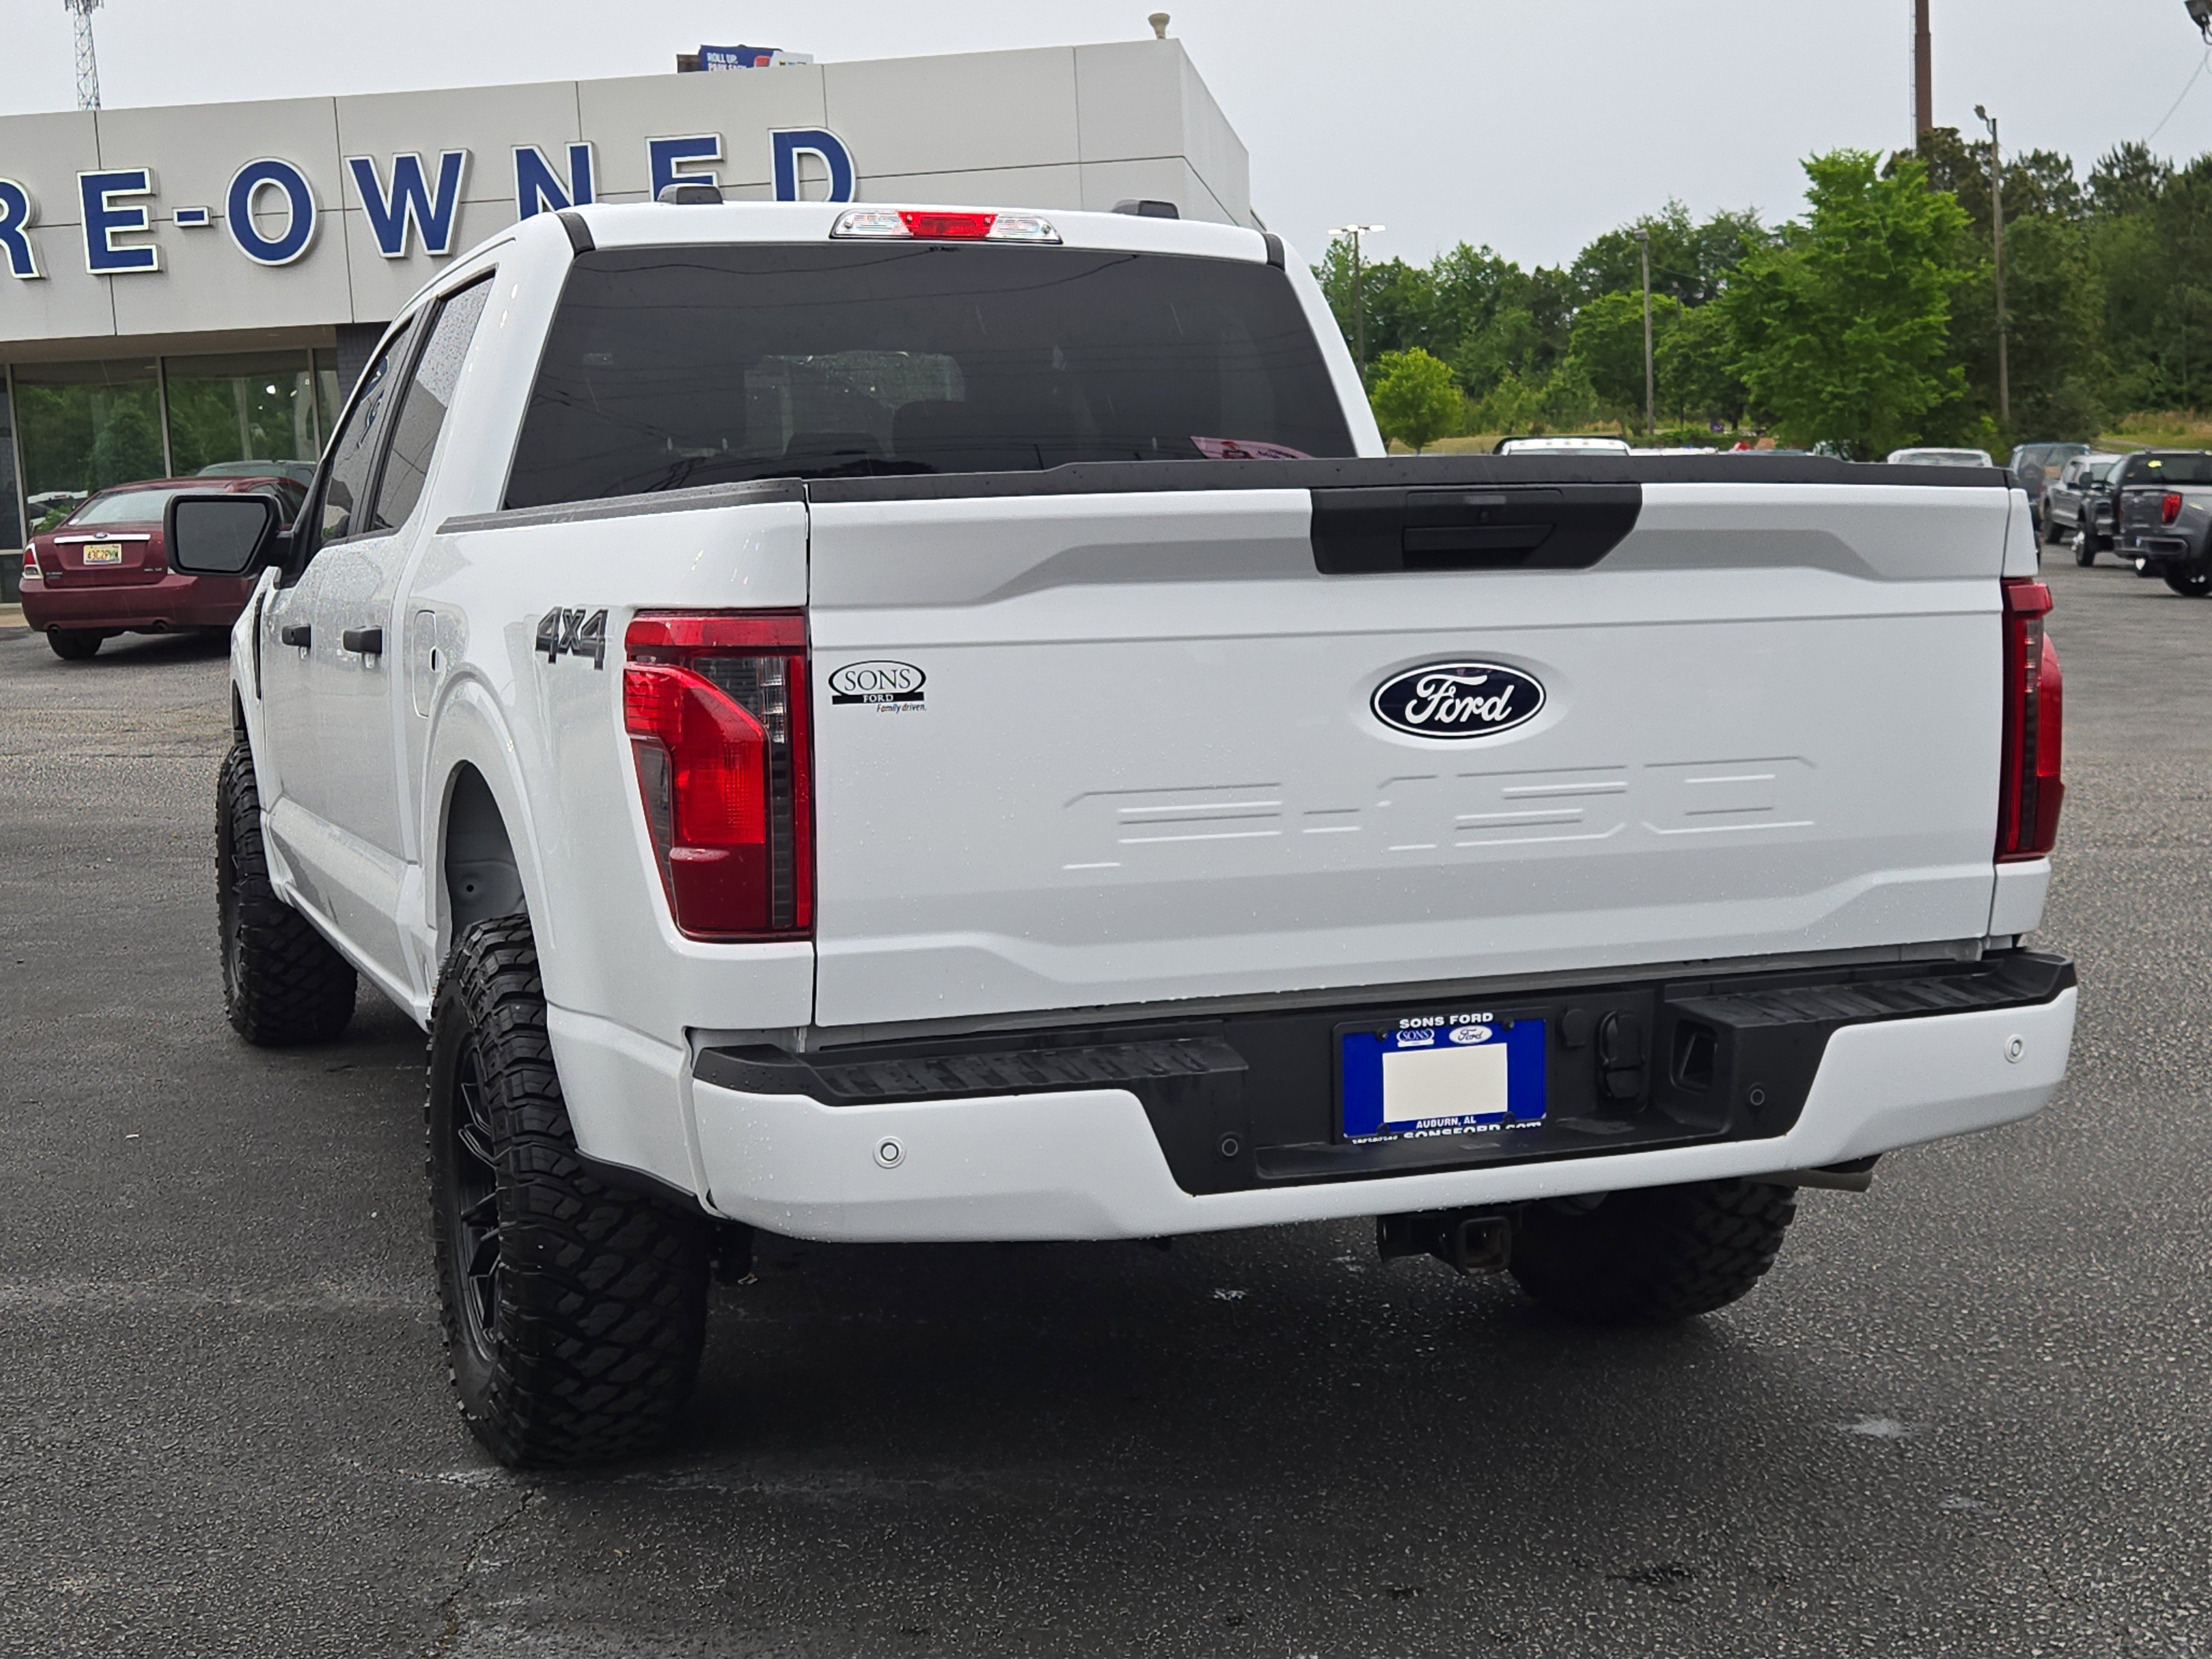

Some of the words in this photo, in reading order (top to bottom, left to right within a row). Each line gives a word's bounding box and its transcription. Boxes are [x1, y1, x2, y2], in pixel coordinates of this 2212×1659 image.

[706, 53, 725, 62] ROLL
[844, 668, 911, 691] SONS
[863, 695, 894, 703] FORD
[1405, 673, 1515, 724] Ford
[876, 704, 901, 714] Family
[1399, 1016, 1445, 1029] SONS
[1449, 1012, 1494, 1025] FORD
[1457, 1028, 1484, 1041] Ford
[1416, 1117, 1462, 1129] AUBURN,
[1463, 1115, 1477, 1124] AL
